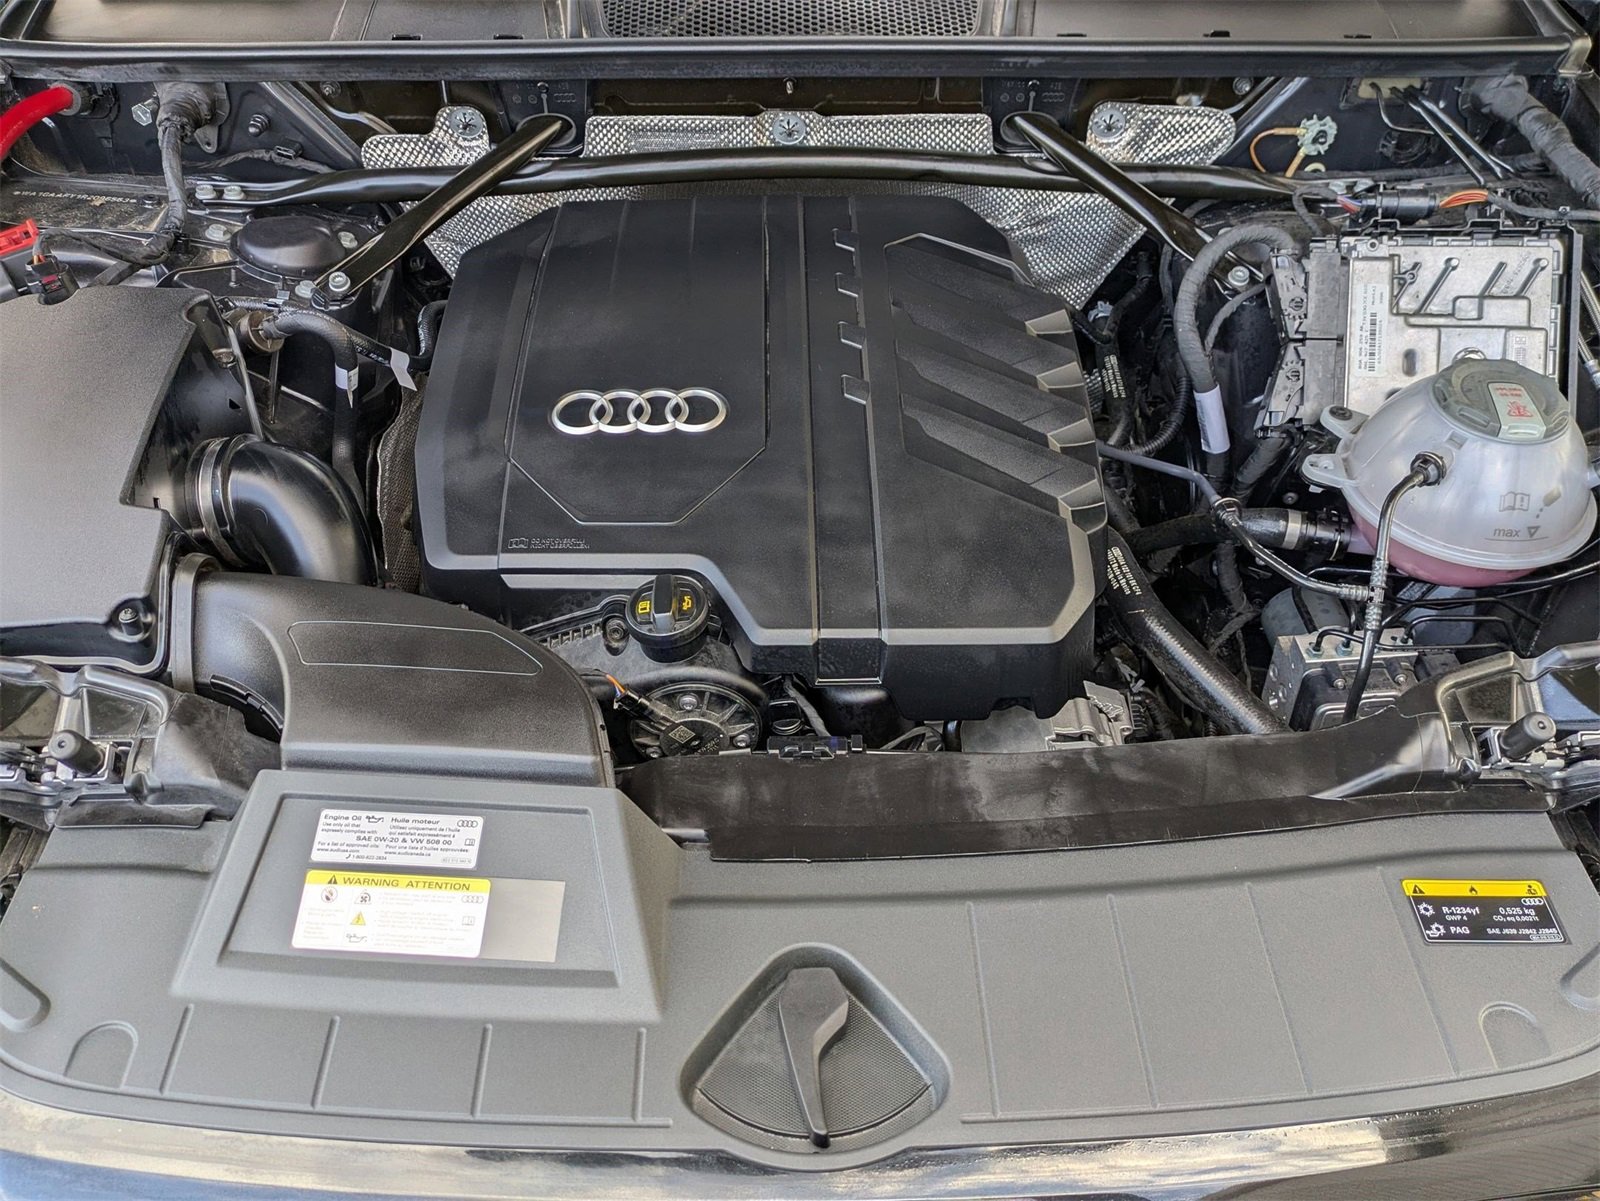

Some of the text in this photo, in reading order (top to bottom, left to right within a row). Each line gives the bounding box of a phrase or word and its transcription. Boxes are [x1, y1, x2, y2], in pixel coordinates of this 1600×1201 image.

[1494, 528, 1520, 537] max
[343, 877, 471, 891] WARNING ATTENTION
[1442, 907, 1480, 916] R-1234yf
[1523, 908, 1535, 916] kg
